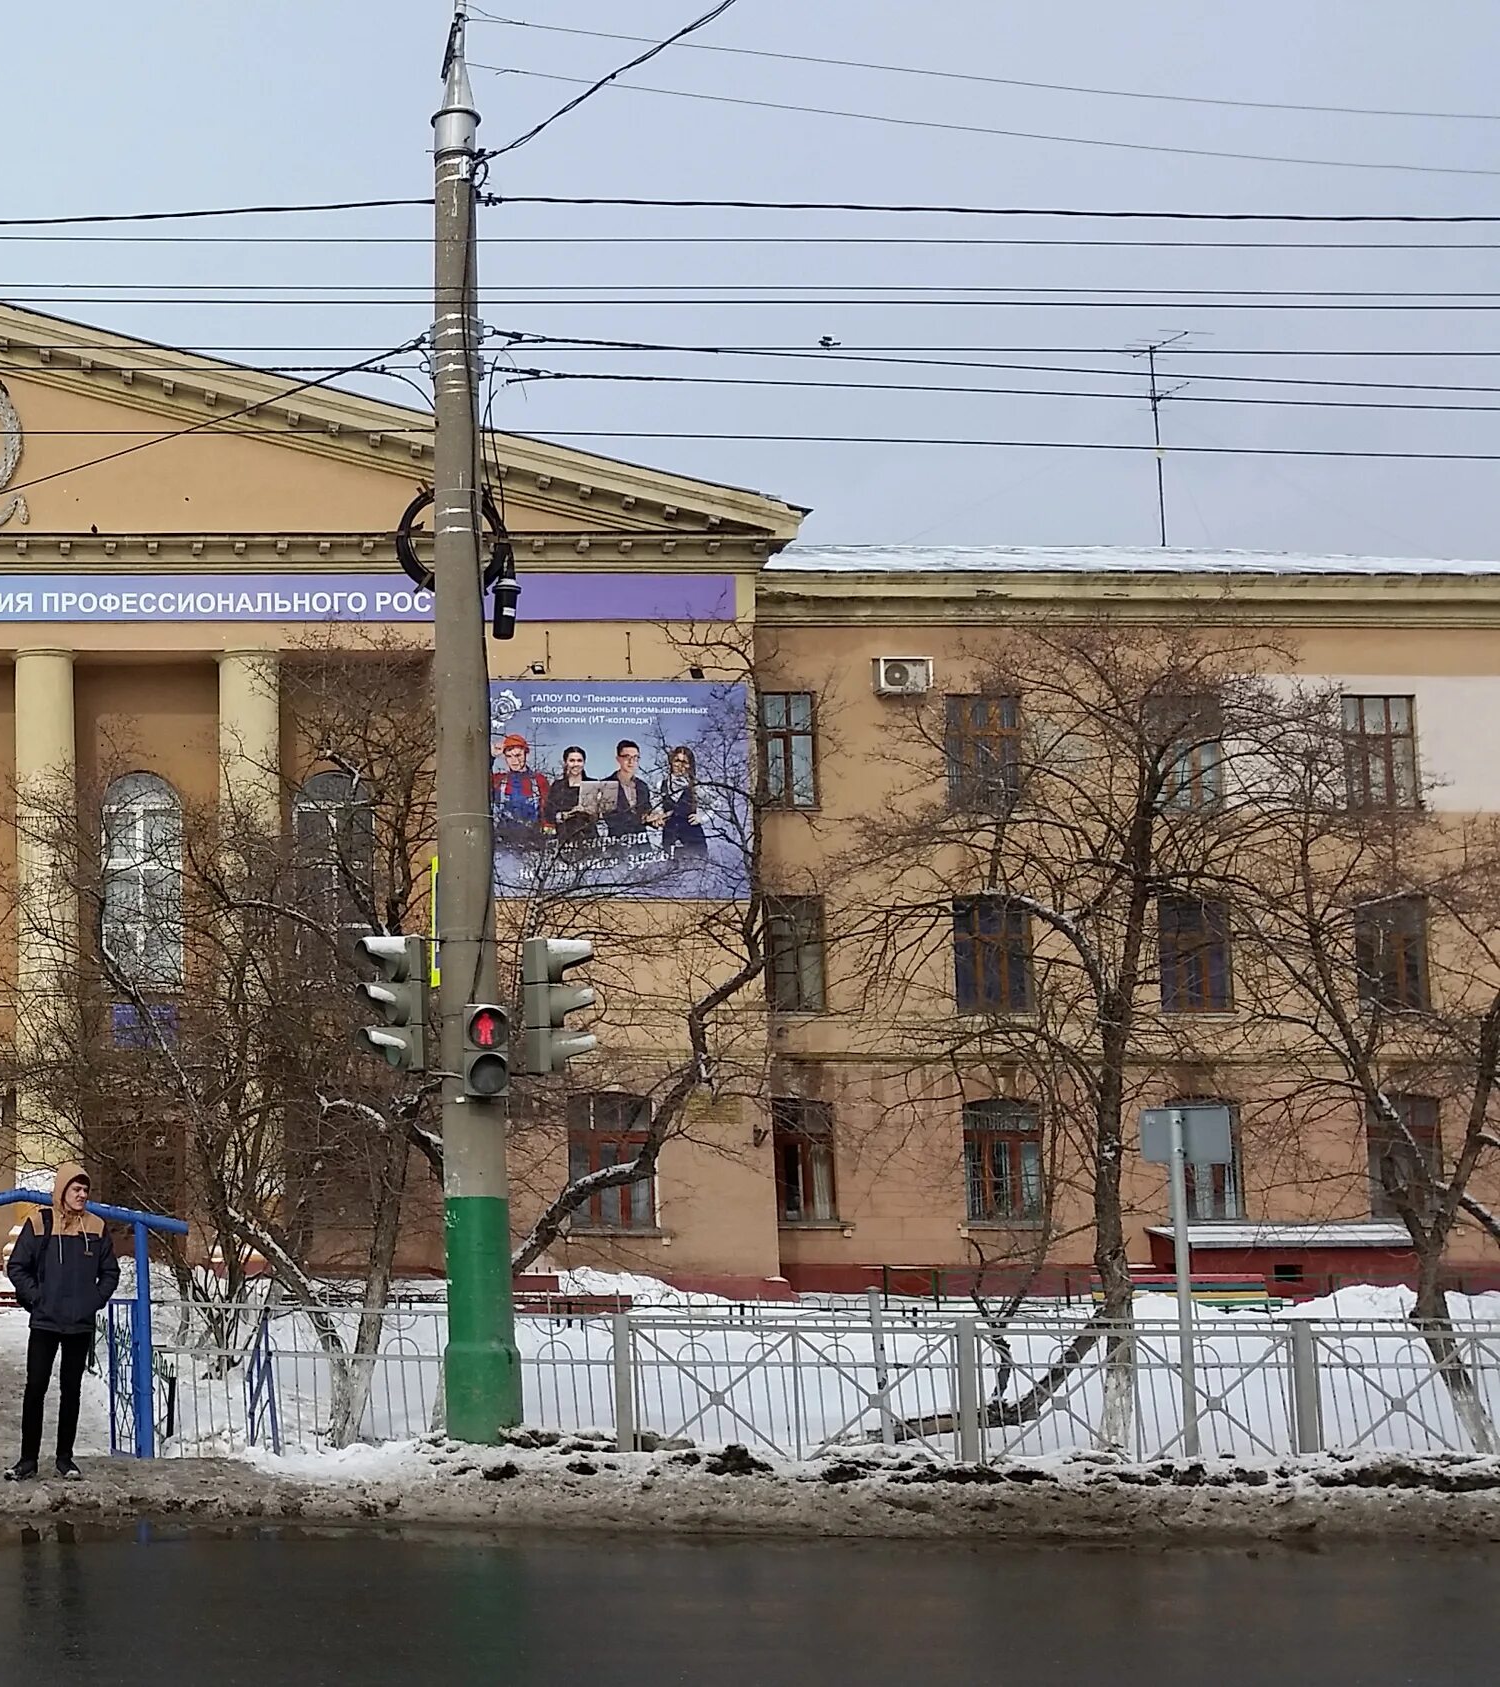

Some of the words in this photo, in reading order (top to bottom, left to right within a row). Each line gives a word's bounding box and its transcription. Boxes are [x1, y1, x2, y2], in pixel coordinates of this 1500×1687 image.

[42, 592, 367, 613] ПРОФЕССИОНАЛЬНОГО
[375, 592, 435, 613] РОС
[531, 694, 563, 702] ГАПОУ
[565, 694, 580, 702] ПО
[531, 705, 619, 714] информационных
[629, 706, 708, 714] промышленных
